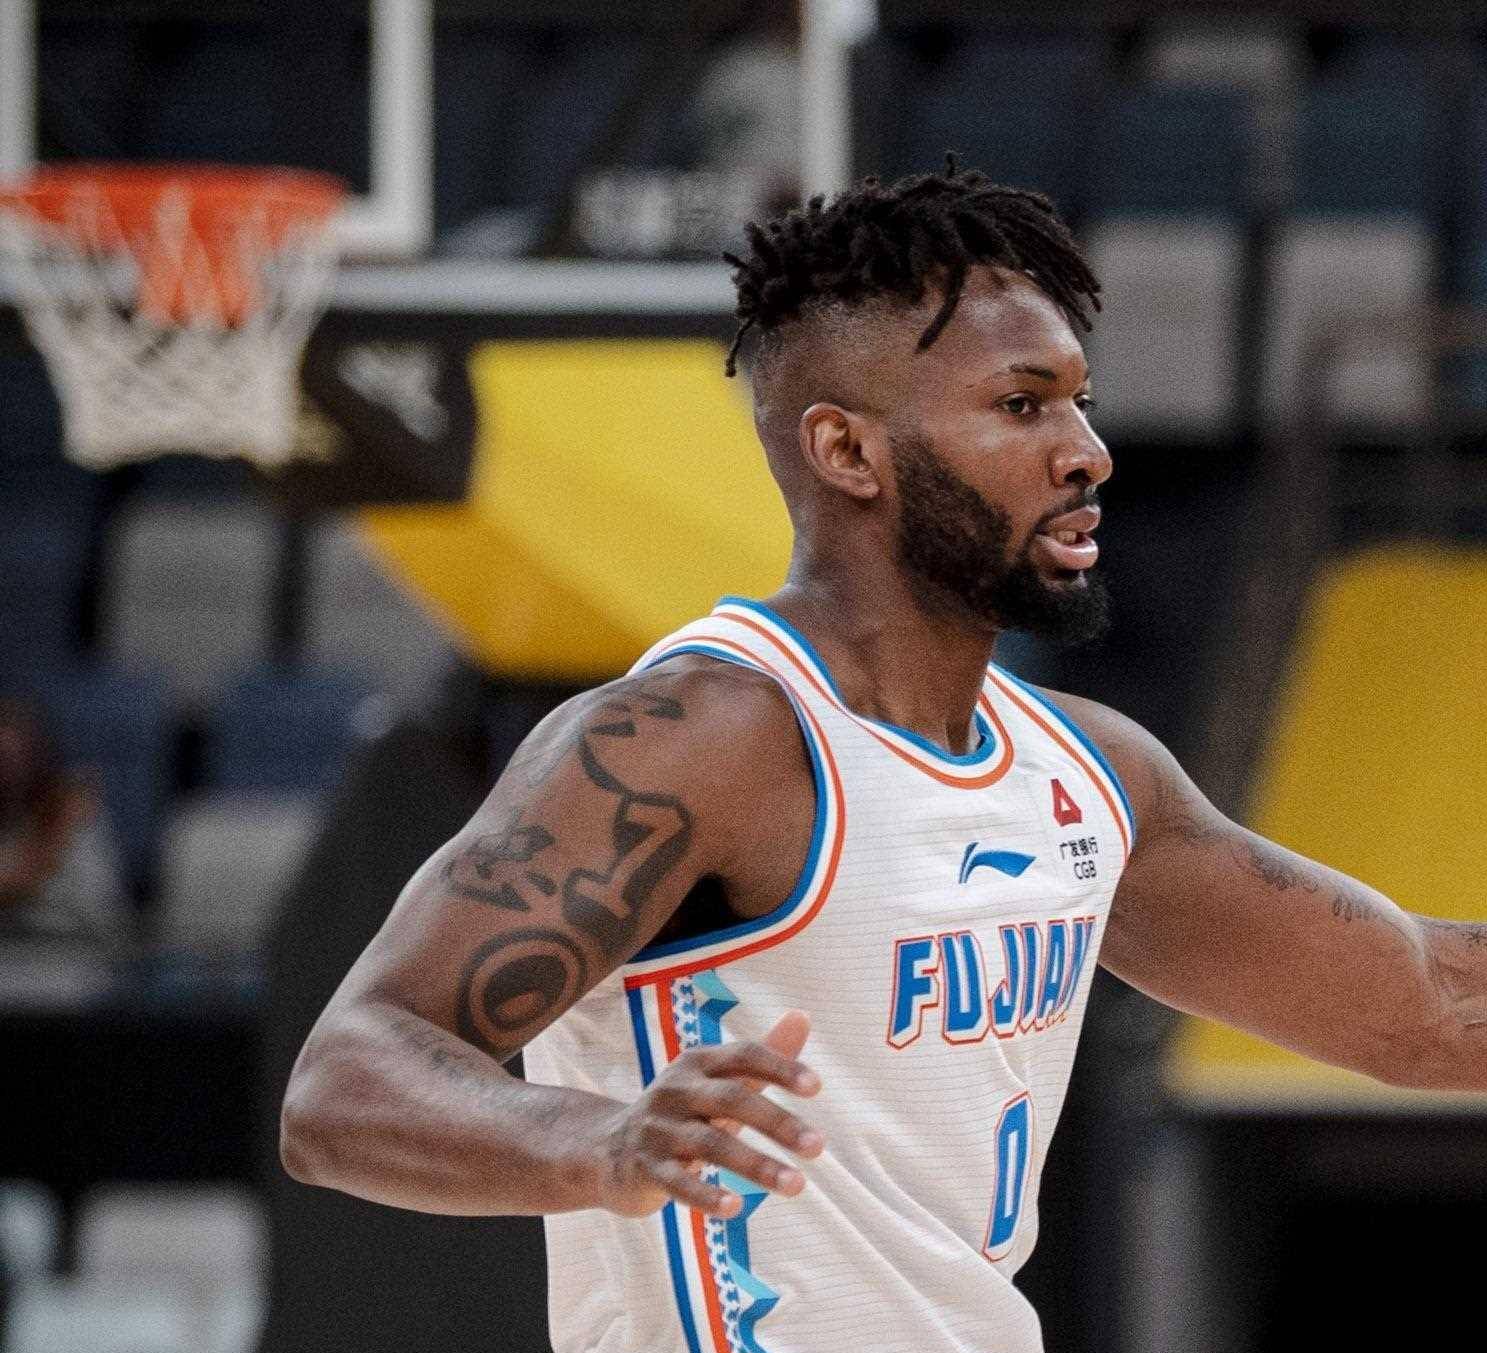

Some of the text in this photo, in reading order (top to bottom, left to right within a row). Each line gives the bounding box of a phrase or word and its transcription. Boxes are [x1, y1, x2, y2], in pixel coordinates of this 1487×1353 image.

[1059, 836, 1099, 860] 广发银行
[1073, 860, 1097, 880] CGB
[982, 1090, 1035, 1263] 0
